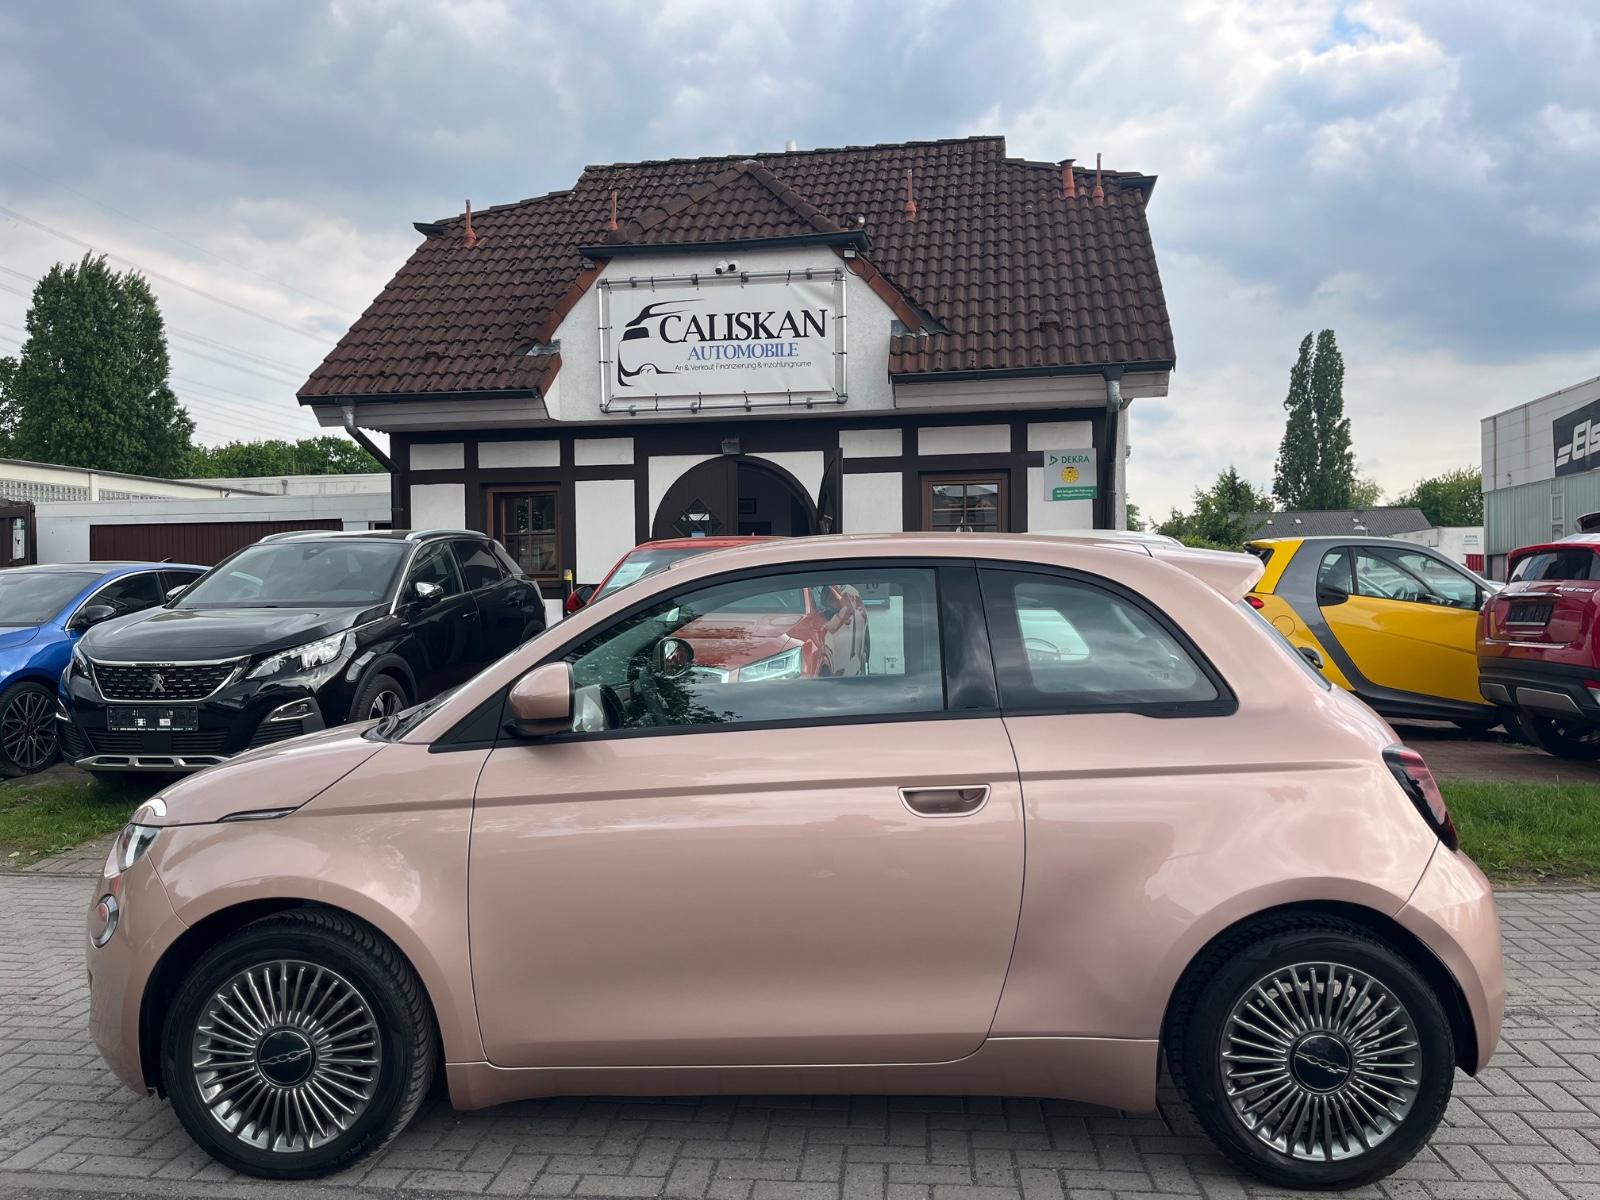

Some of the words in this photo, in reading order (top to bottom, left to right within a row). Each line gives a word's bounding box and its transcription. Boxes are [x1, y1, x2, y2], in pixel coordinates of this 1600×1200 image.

[659, 309, 828, 343] CALISKAN
[688, 342, 799, 361] AUTOMOBILE
[715, 361, 757, 370] Finanzierung
[1061, 455, 1090, 464] DEKRA
